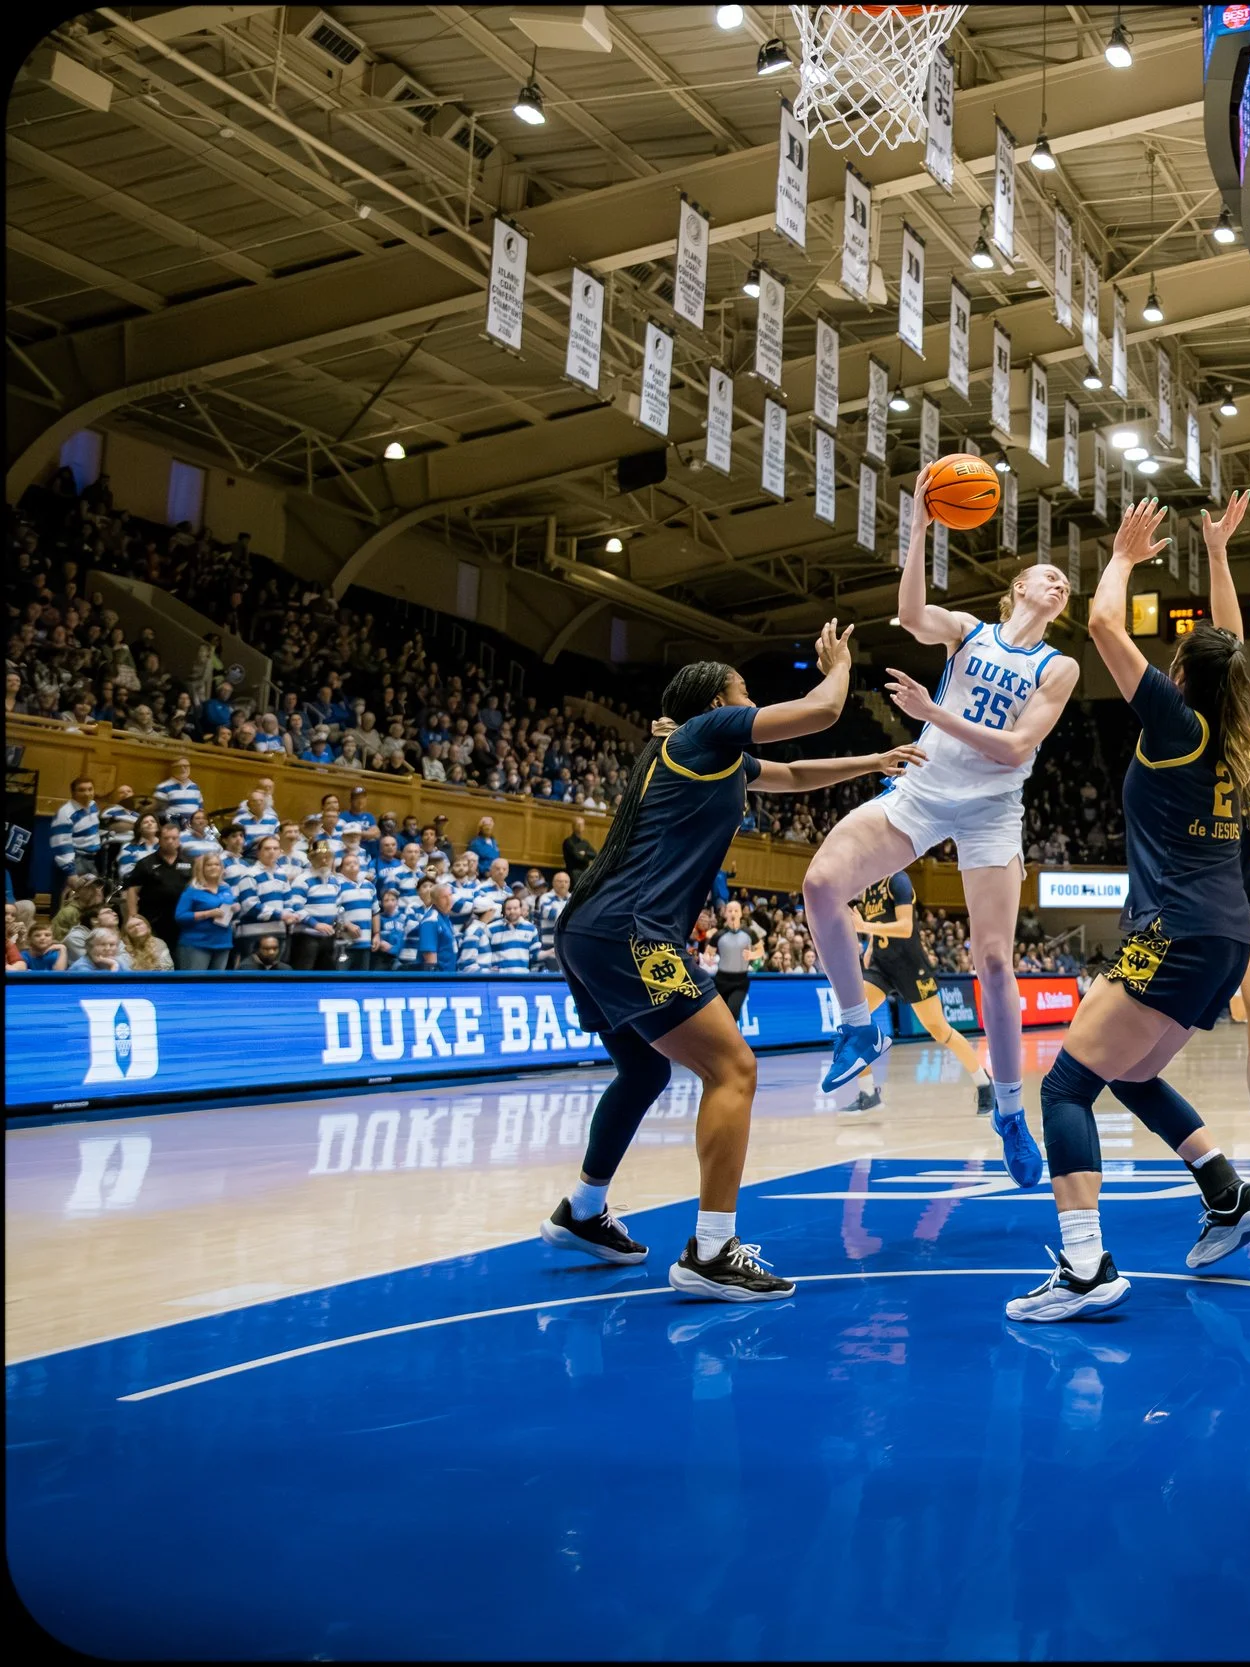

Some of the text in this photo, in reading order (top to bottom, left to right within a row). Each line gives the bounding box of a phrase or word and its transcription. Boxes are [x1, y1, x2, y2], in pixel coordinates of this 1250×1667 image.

[1175, 618, 1195, 635] 67
[964, 655, 1032, 701] DUKE
[962, 685, 1013, 731] 35
[1212, 759, 1235, 818] 2
[1188, 818, 1240, 840] de JESUS
[1050, 883, 1122, 897] FOOD LION
[940, 986, 965, 1006] North
[943, 1007, 975, 1022] Carolina
[318, 997, 486, 1066] DUKE
